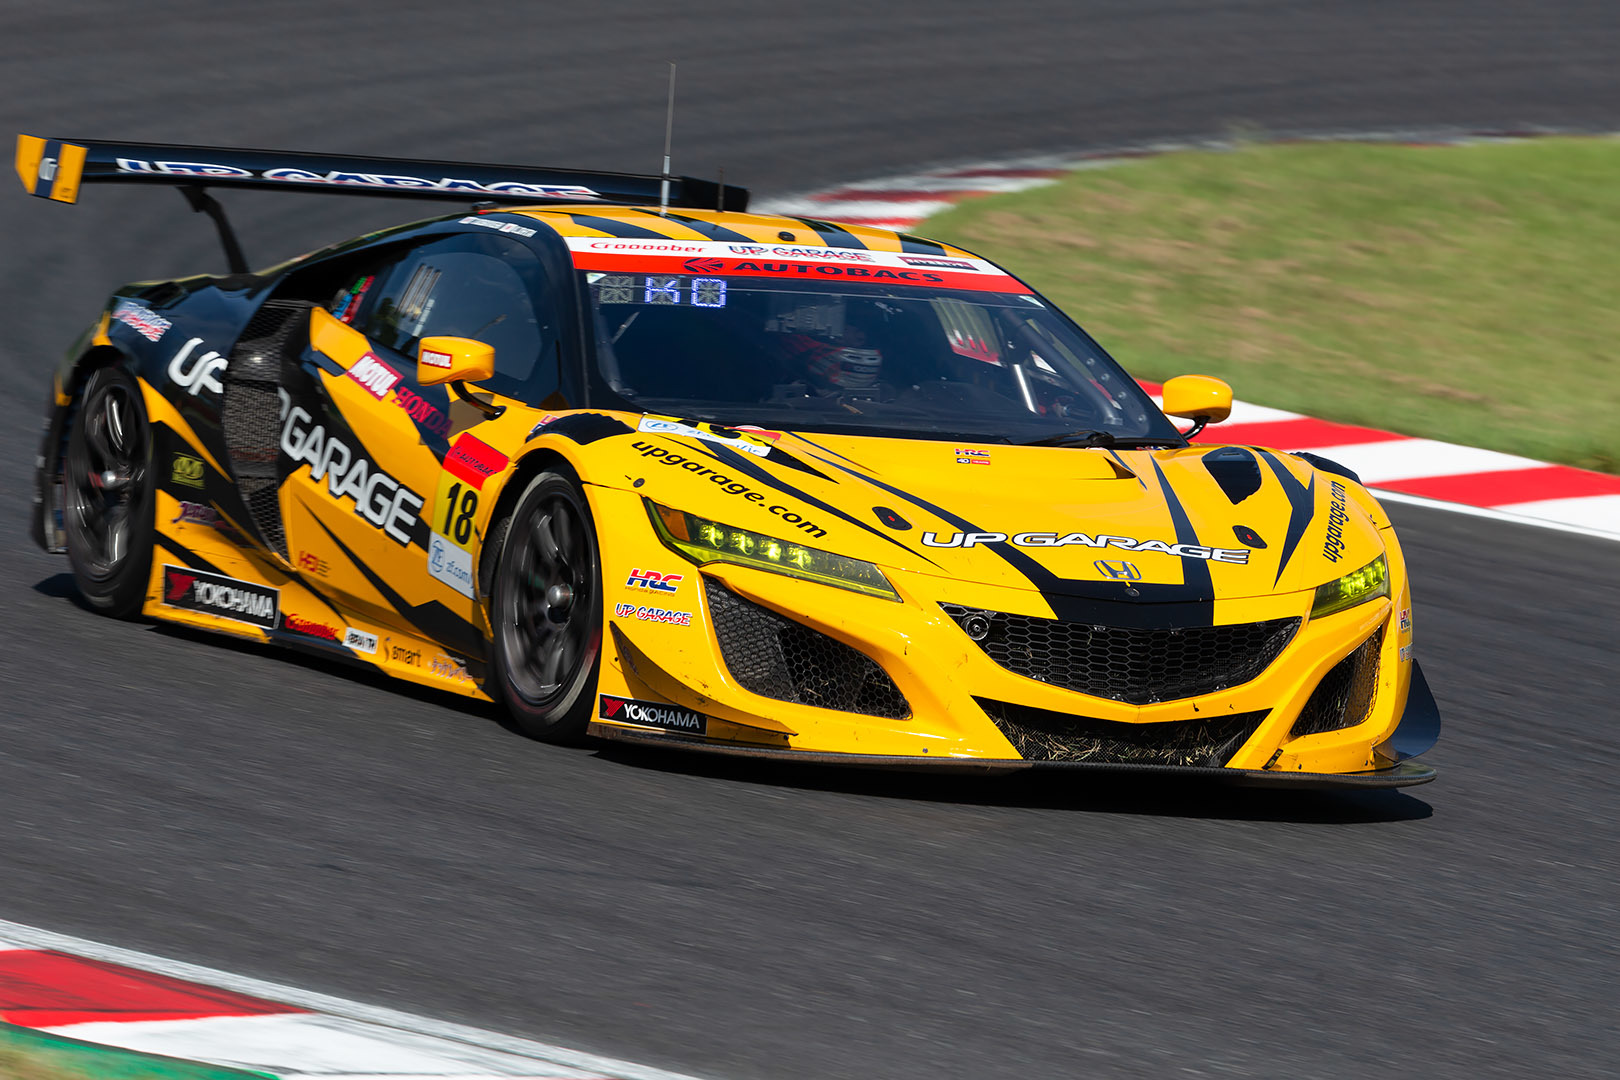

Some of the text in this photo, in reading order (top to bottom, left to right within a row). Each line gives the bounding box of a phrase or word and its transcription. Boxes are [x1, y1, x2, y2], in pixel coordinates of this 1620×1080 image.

[728, 245, 875, 263] UP GARAGE
[732, 262, 945, 283] AUTOBACS
[421, 350, 452, 369] MOTUL
[349, 354, 399, 398] MOTUL
[391, 386, 453, 441] HONDA
[954, 448, 991, 457] HRC
[280, 406, 425, 545] GARAGE
[631, 439, 828, 539] upgarage.com
[442, 482, 478, 545] 18
[1322, 480, 1350, 564] upgarage.com
[922, 531, 1252, 565] UP GARAGE
[625, 567, 684, 593] HRC
[193, 579, 275, 620] YOKOHAMA
[615, 602, 693, 626] UP GARAGE
[391, 645, 421, 668] smart
[623, 703, 700, 729] YOKOHAMA
